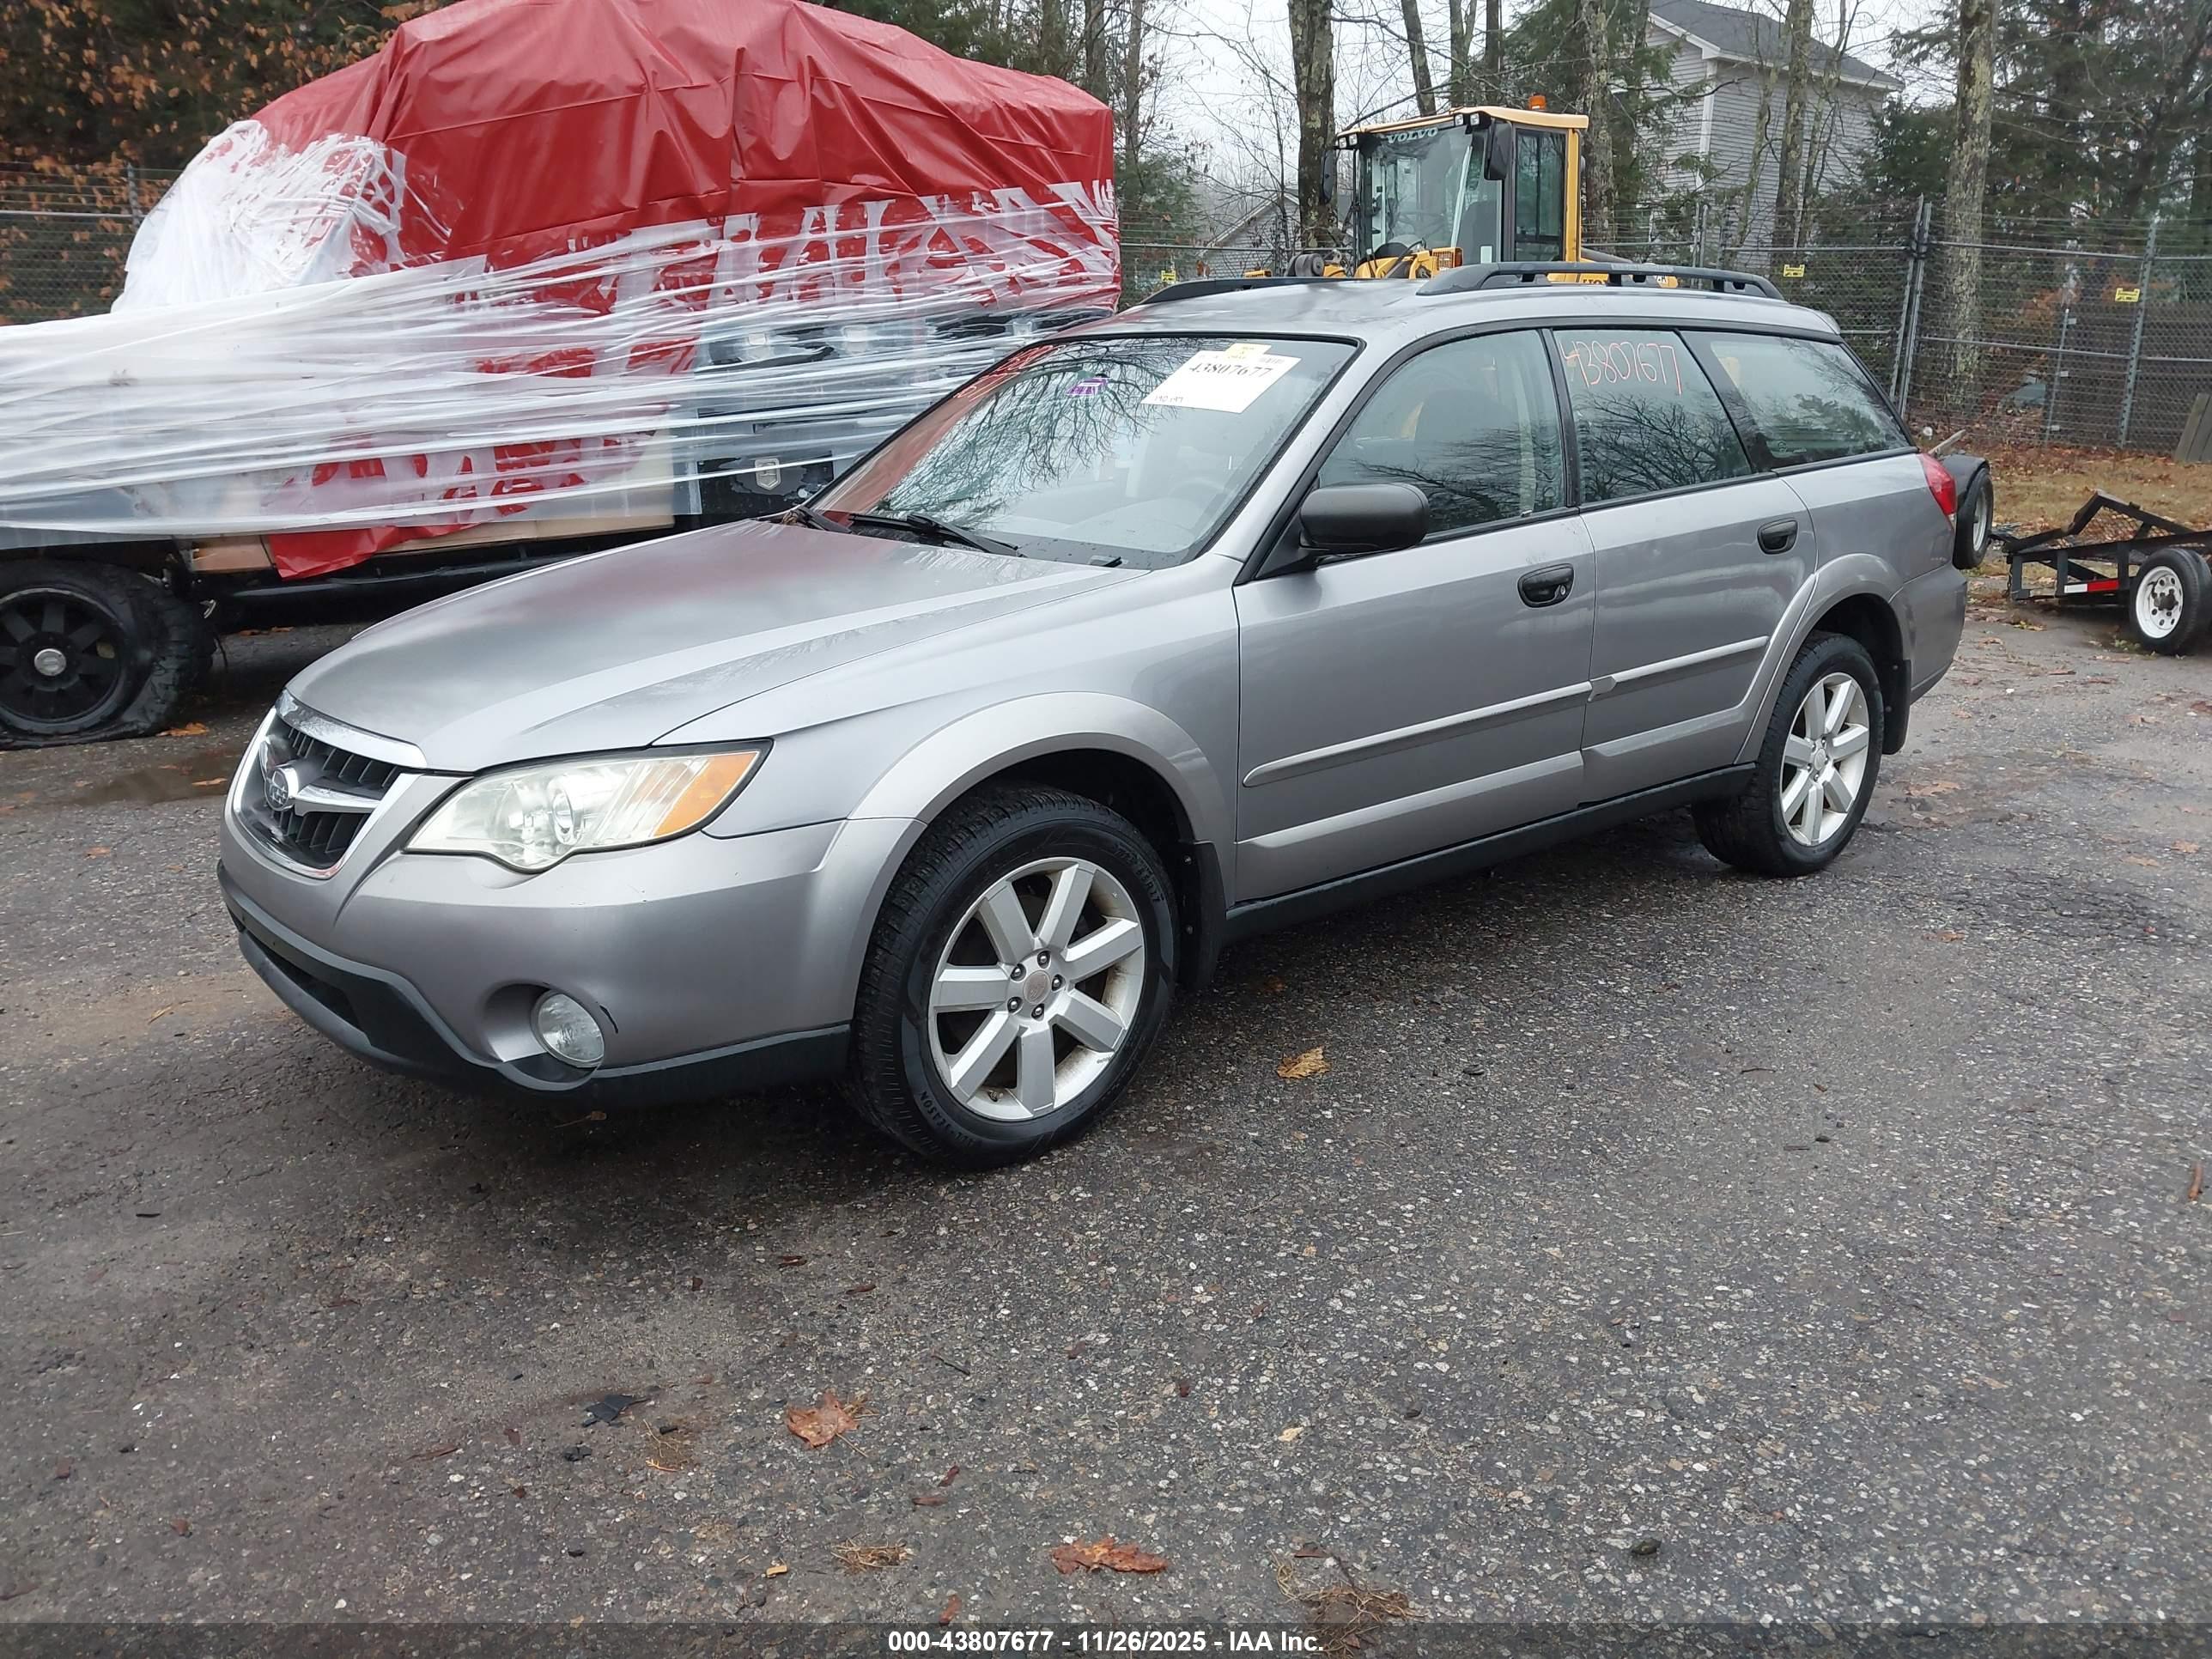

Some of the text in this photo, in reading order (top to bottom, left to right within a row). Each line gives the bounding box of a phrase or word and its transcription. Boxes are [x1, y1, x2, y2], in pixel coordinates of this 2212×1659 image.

[1387, 127, 1438, 143] VOLVO
[1188, 362, 1273, 378] 43807677
[1559, 340, 1682, 395] 43807677
